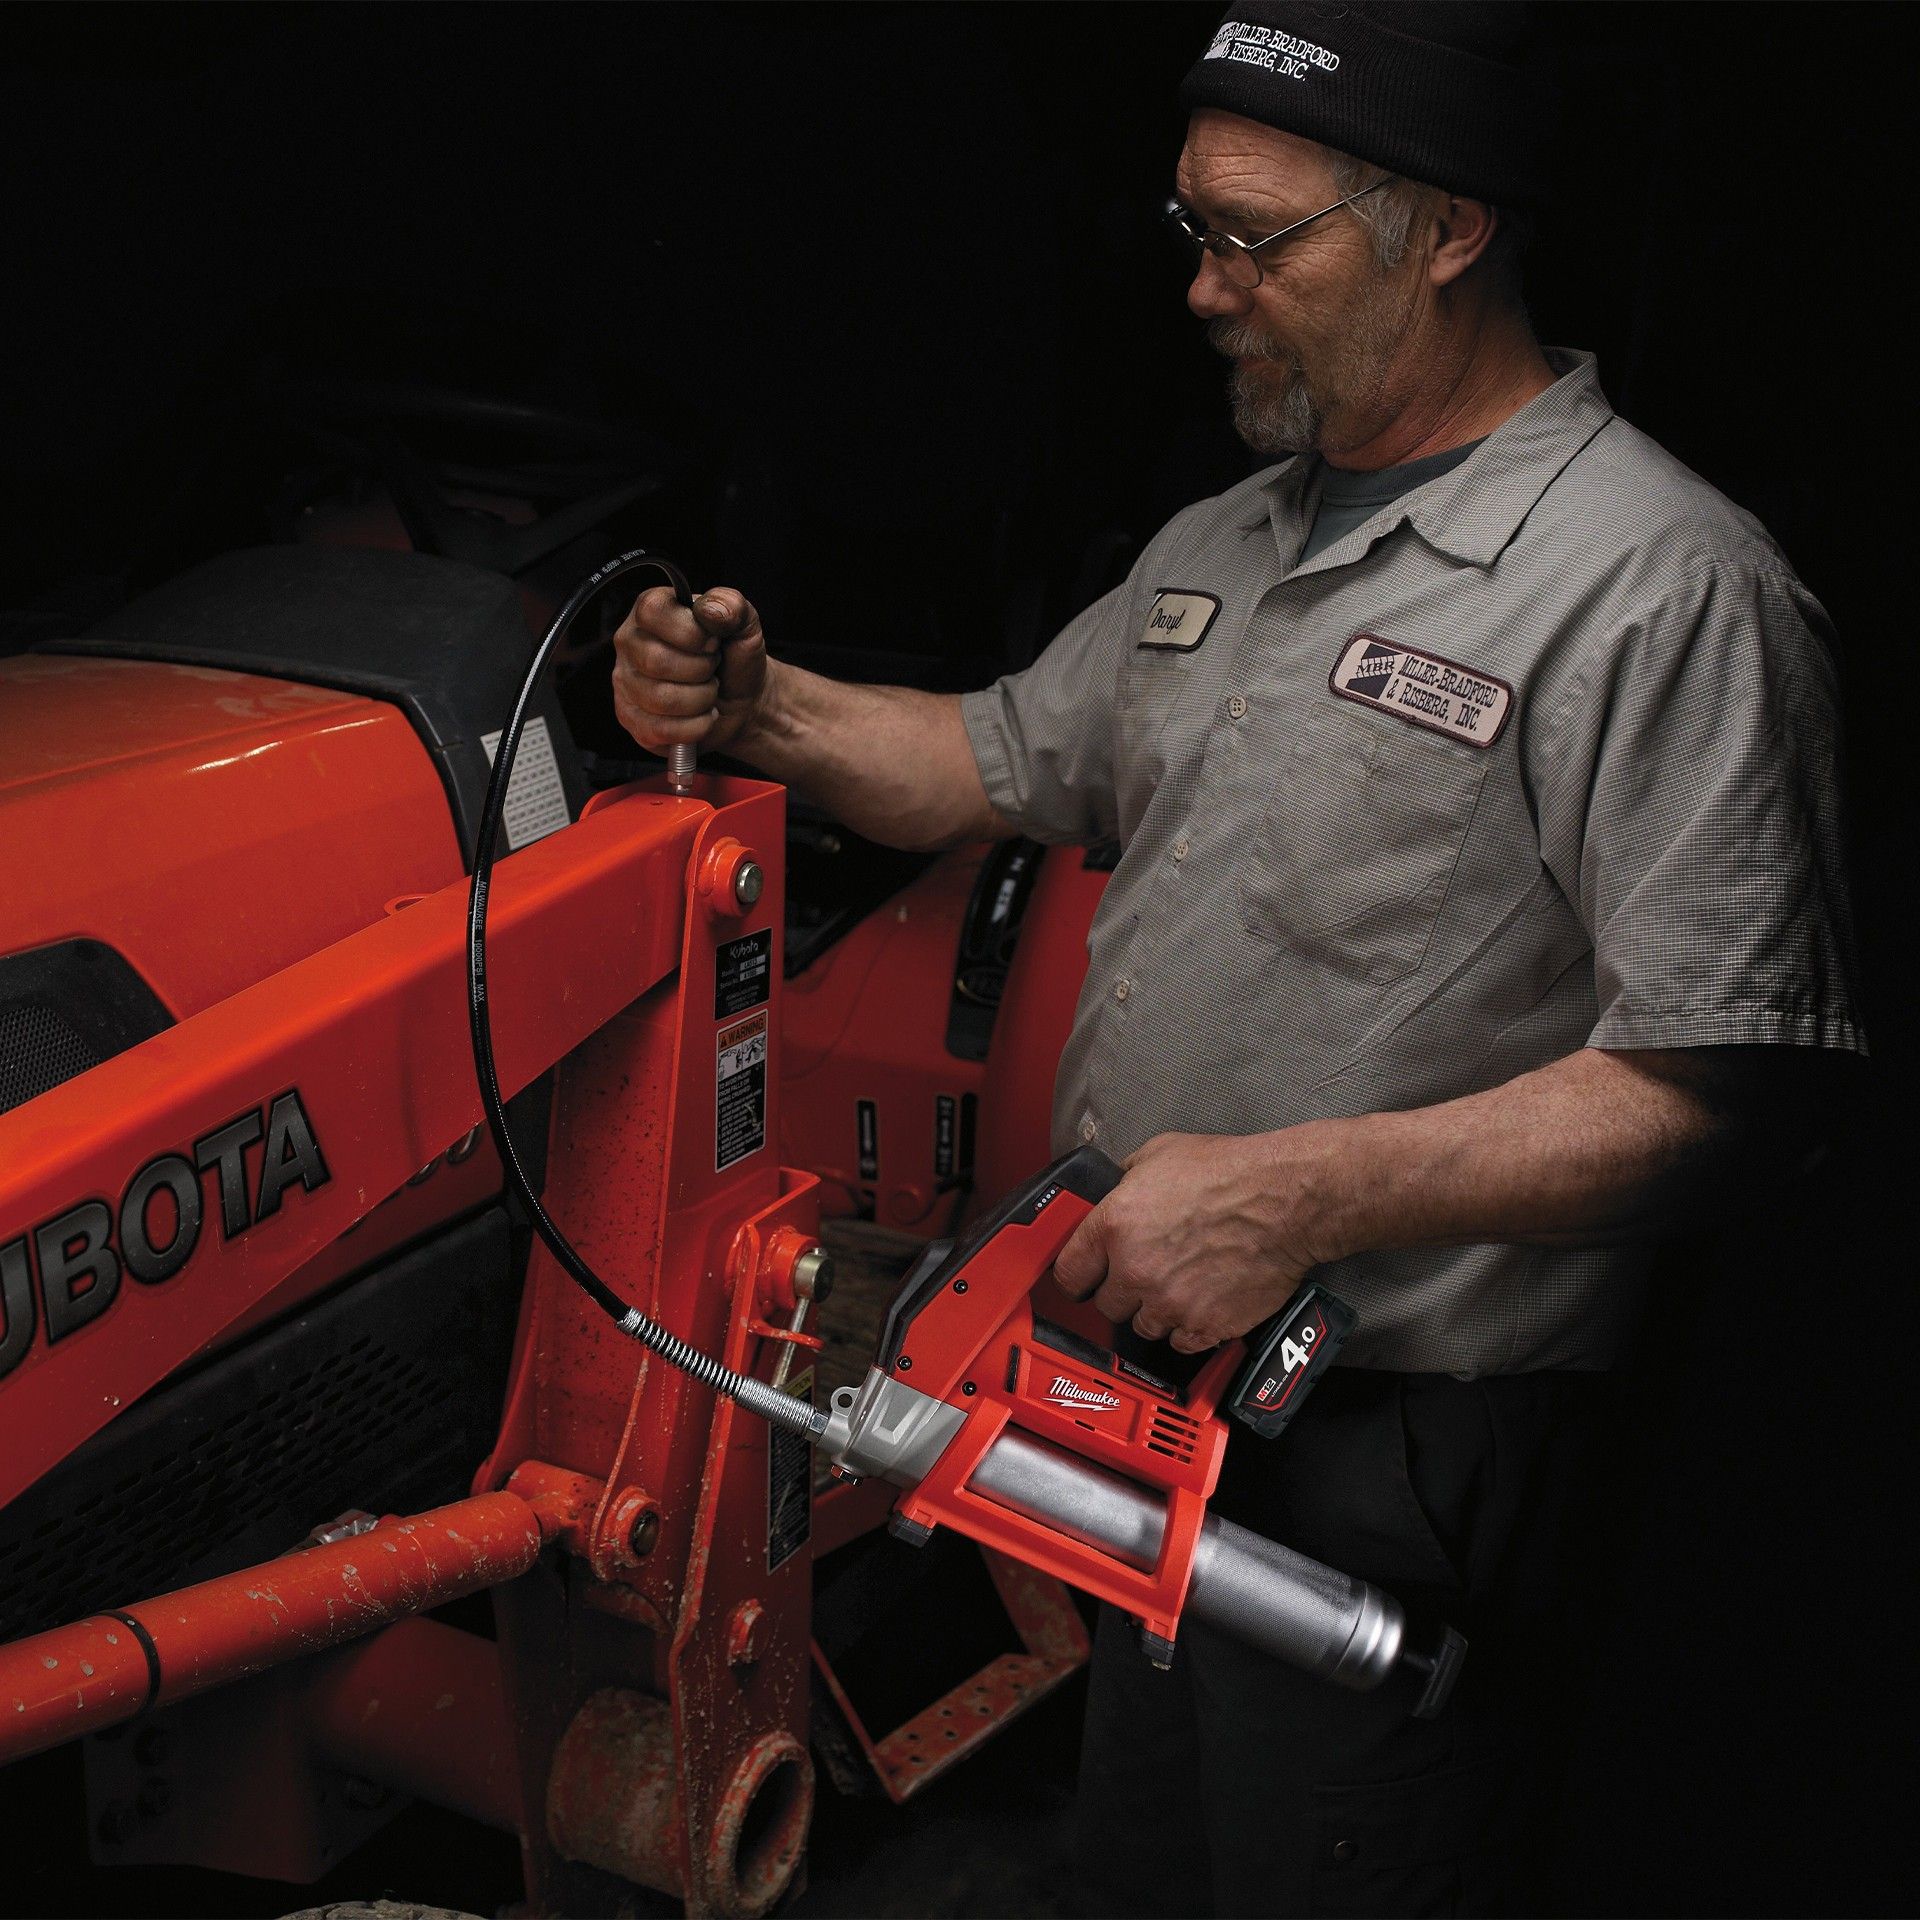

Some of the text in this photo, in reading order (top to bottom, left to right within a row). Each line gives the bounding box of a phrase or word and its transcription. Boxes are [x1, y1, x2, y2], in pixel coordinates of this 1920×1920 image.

[1228, 42, 1277, 73] RISBERG,
[1277, 56, 1309, 82] INC.
[1233, 22, 1340, 72] MILLER-BRADFORD
[1150, 607, 1186, 635] Daryl
[1397, 654, 1499, 708] MILLER-BRADFORD
[1386, 678, 1483, 732] & RISBERG, INC.
[475, 880, 487, 930] MILWAUKEE
[477, 983, 485, 1002] MAX
[728, 1017, 764, 1043] WARNING
[1281, 1326, 1316, 1374] 4.0
[1049, 1375, 1121, 1407] Milwaukee
[1257, 1378, 1275, 1401] M12
